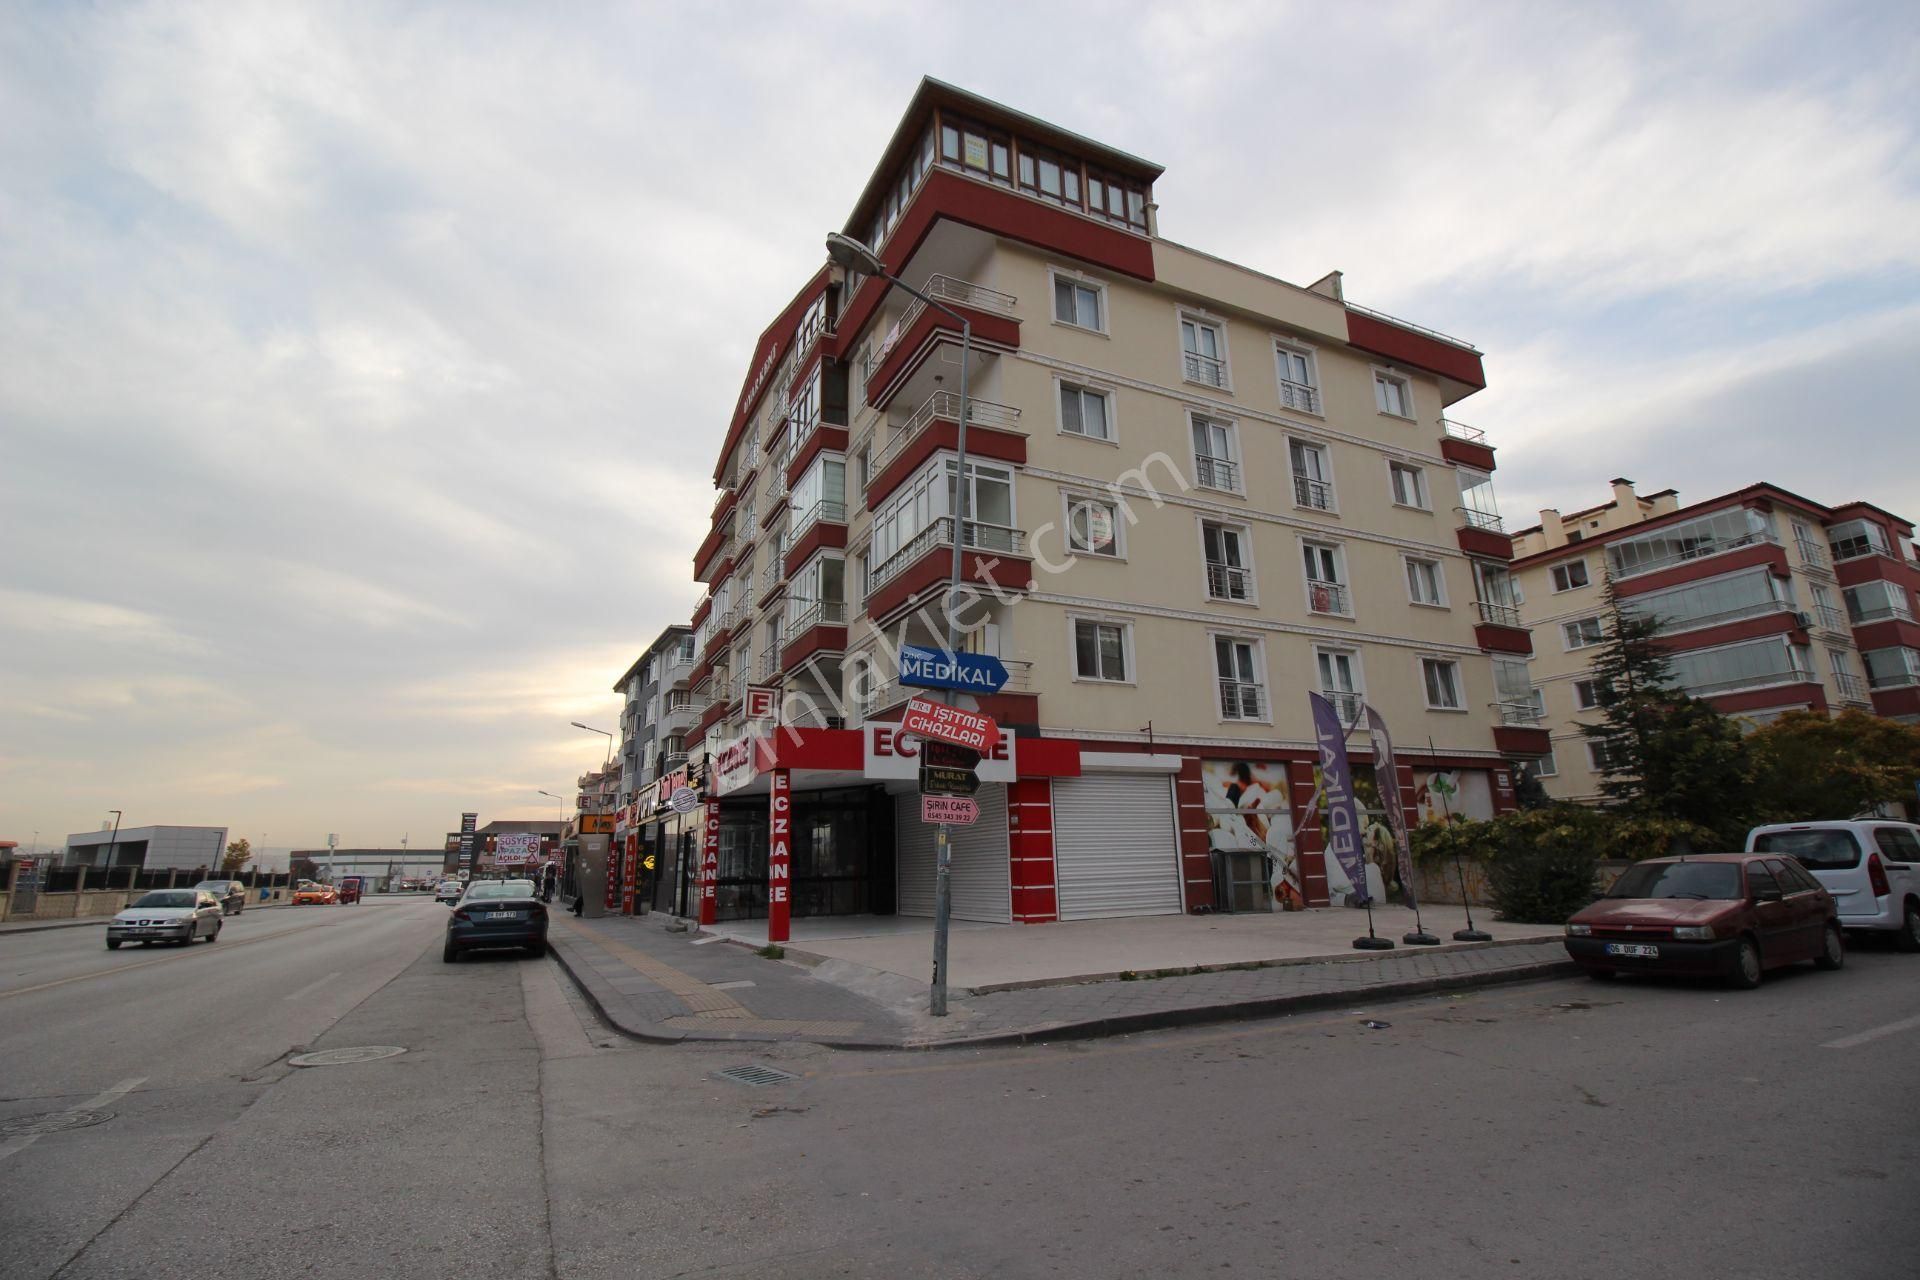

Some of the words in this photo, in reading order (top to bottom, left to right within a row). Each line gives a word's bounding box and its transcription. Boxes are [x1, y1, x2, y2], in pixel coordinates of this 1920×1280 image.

[903, 659, 997, 687] MEDİKAL
[909, 716, 985, 747] CİHAZLARI
[933, 706, 988, 732] İŞİTME
[933, 770, 968, 781] MURAT
[926, 800, 948, 812] ŞİRİN
[950, 801, 971, 812] CAFE
[705, 803, 719, 898] ECZANE
[774, 774, 789, 903] ECZANE
